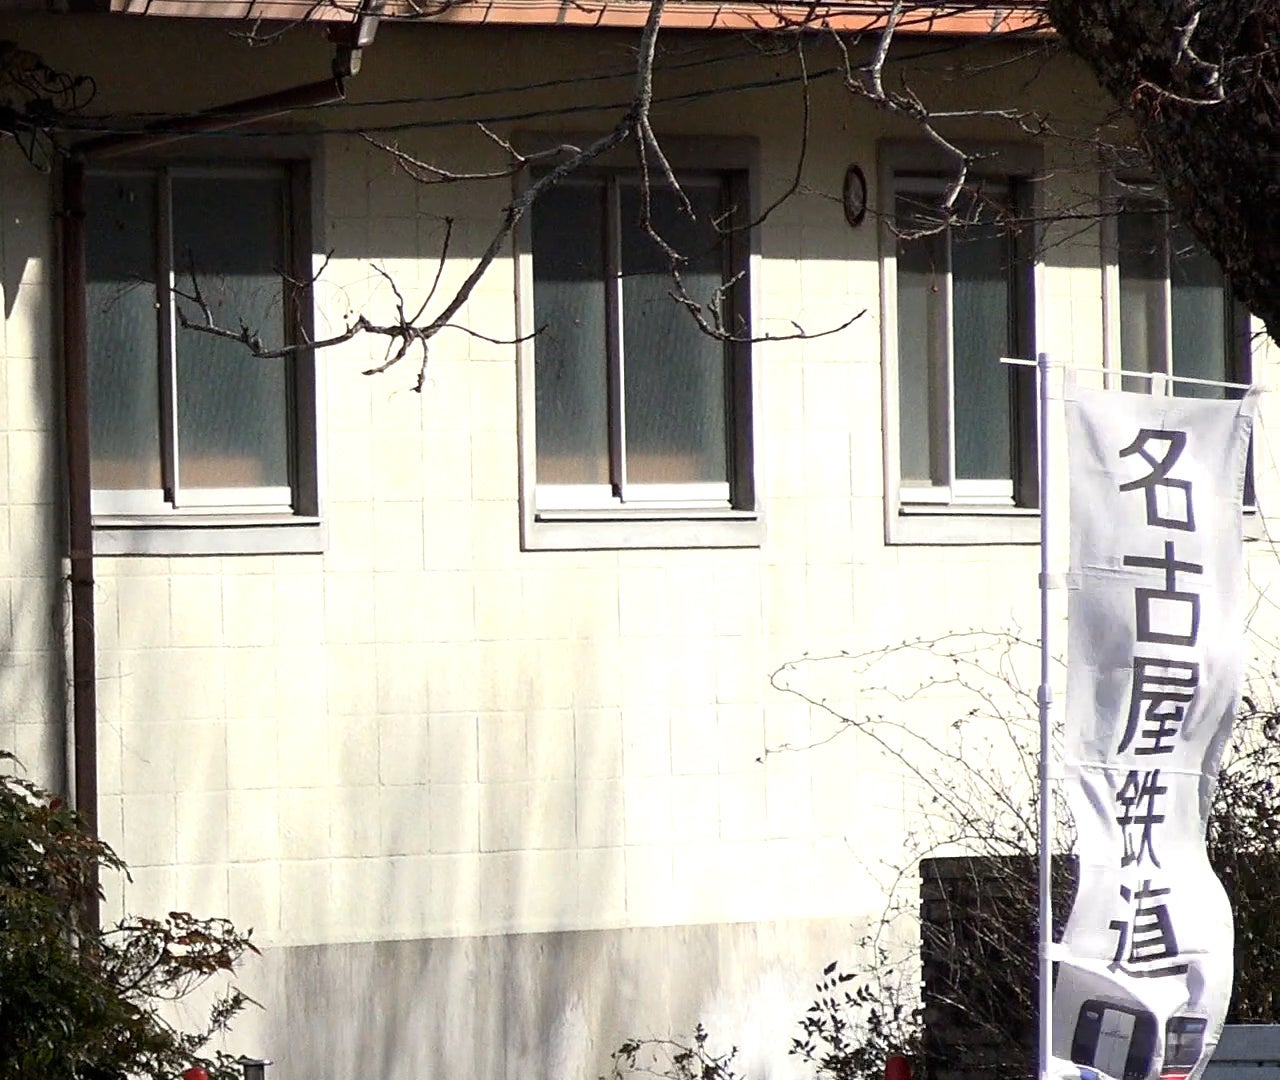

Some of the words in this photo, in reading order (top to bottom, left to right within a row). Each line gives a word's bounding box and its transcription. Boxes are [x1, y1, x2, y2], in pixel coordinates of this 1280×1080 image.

[1107, 428, 1203, 979] 名古屋鉄道
